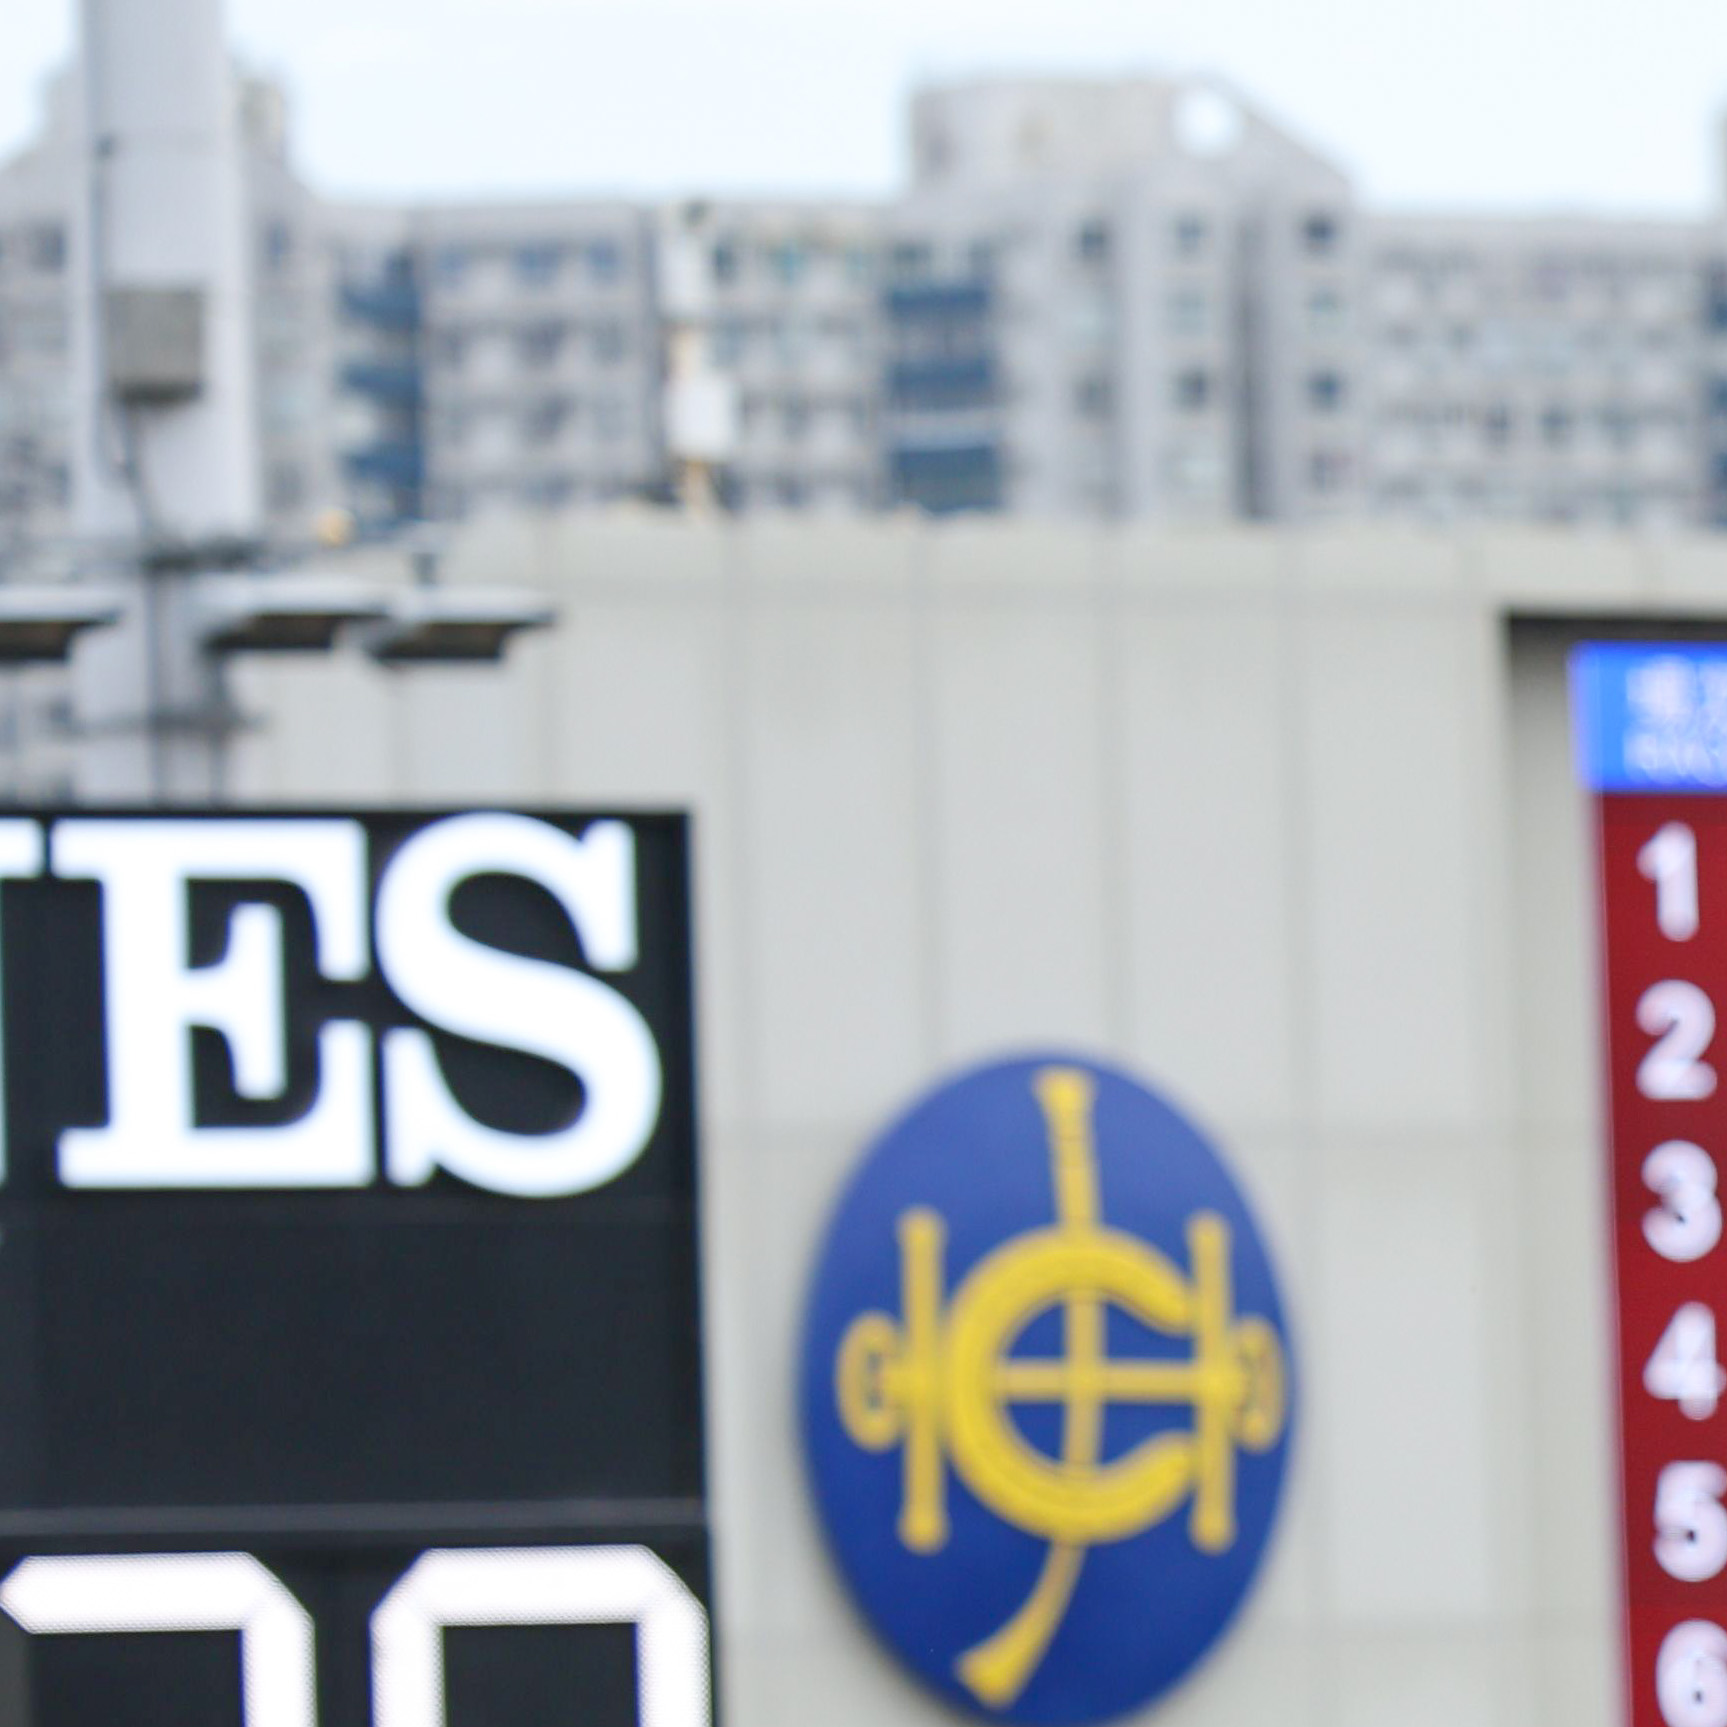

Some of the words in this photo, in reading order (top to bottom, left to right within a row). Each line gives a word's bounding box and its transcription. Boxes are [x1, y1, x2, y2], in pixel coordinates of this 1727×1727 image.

[1636, 821, 1699, 942] 1
[0, 811, 663, 1198] ES
[1636, 979, 1717, 1100] 2
[1641, 1139, 1723, 1262] 3
[1643, 1302, 1727, 1420] 4
